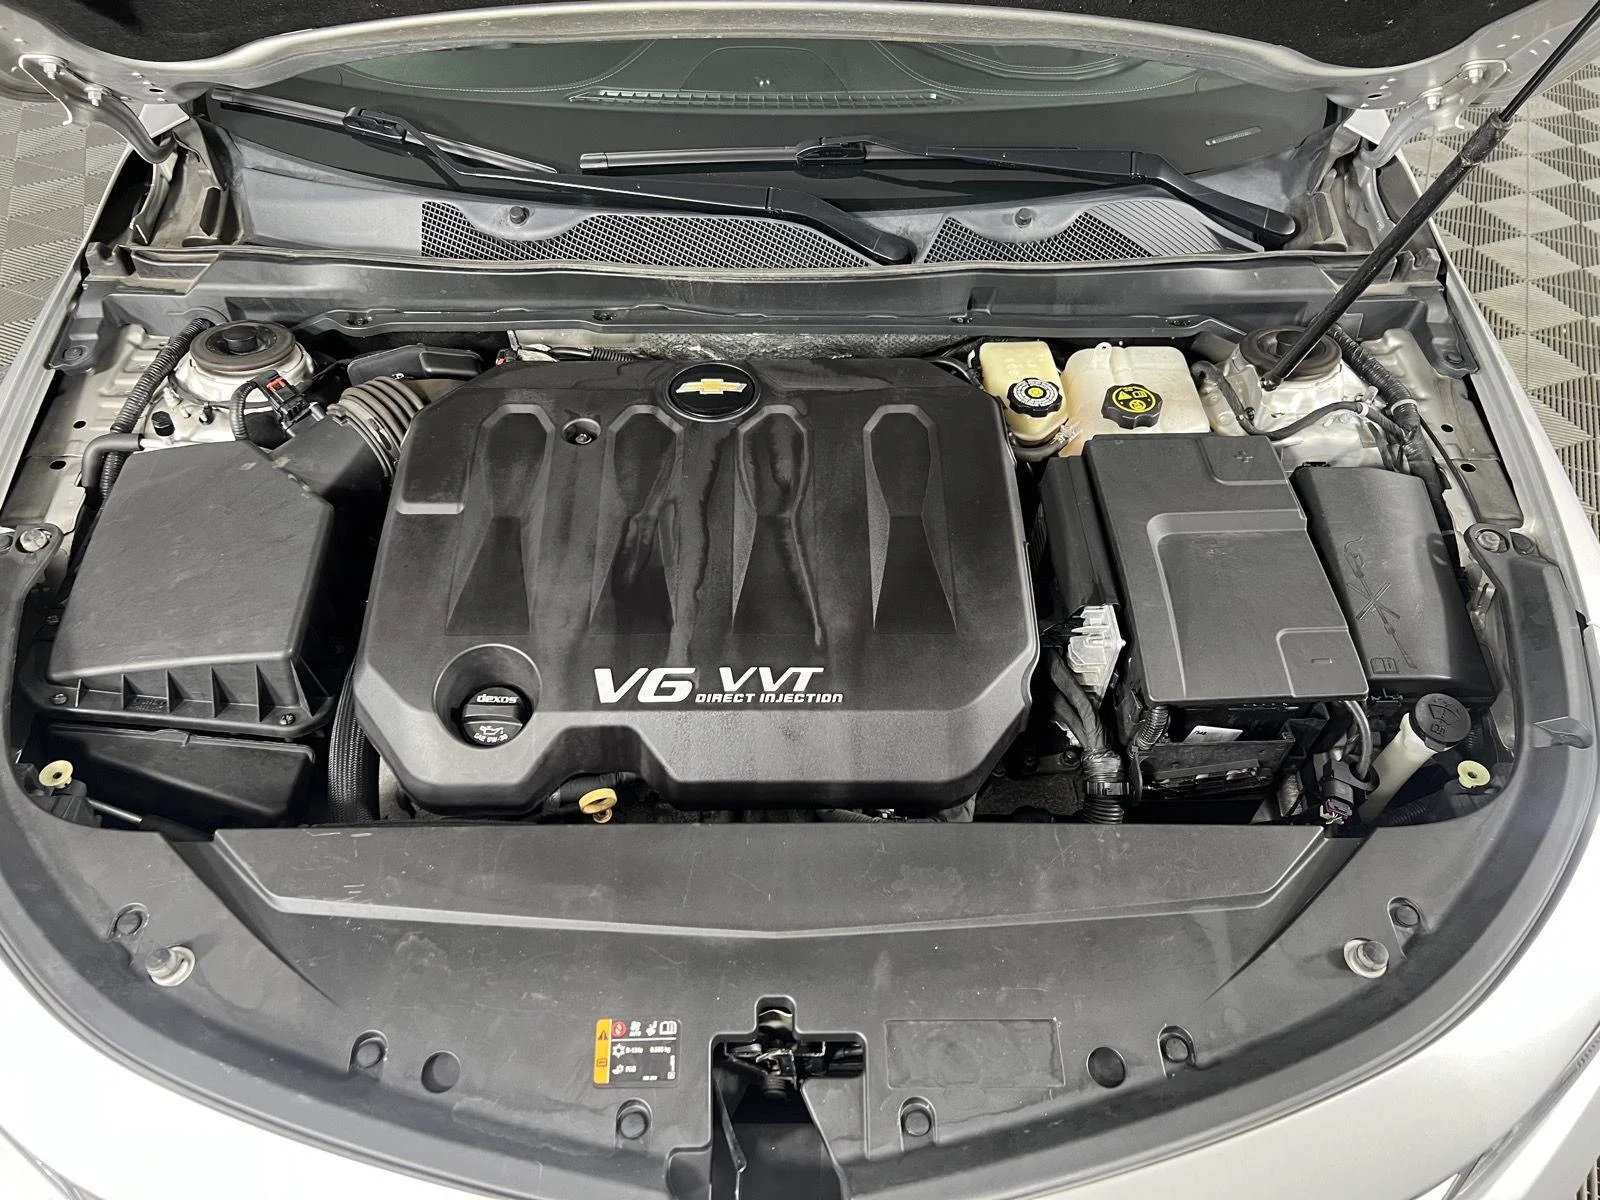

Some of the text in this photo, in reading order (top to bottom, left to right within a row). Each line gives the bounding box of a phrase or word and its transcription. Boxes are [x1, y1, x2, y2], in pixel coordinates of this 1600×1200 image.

[594, 666, 825, 704] V6 VVT
[476, 693, 520, 704] dexos
[695, 693, 844, 703] DIRECT INJECTION
